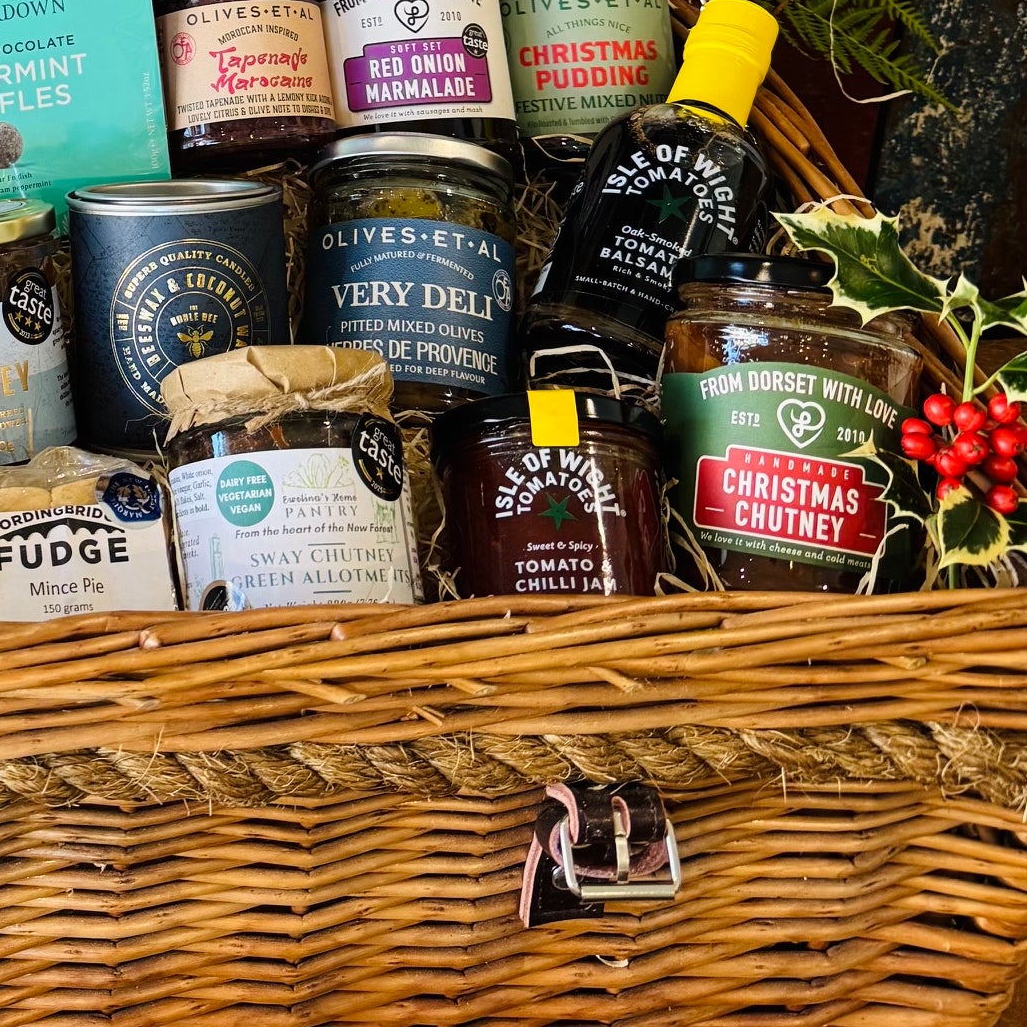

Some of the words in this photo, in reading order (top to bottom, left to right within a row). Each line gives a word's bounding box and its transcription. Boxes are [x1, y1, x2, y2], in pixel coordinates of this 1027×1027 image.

[546, 25, 564, 38] ALL
[565, 18, 605, 30] THINGS
[608, 20, 631, 33] NICE
[390, 43, 416, 54] SOFT
[423, 42, 441, 51] SET
[519, 40, 657, 67] CHRISTMAS
[209, 47, 308, 73] Tapenade
[369, 59, 404, 79] RED
[411, 54, 466, 74] ONION
[211, 73, 313, 94] Marocaine
[536, 66, 649, 91] PUDDING
[366, 77, 475, 103] MARMALADE
[602, 152, 649, 194] ISLE
[655, 144, 689, 162] OF
[693, 154, 735, 241] WIGHT
[626, 167, 714, 224] TOMATOES
[9, 286, 52, 324] taste
[331, 281, 414, 309] VERY
[422, 283, 493, 321] DELI
[341, 320, 383, 333] PITTED
[387, 320, 435, 334] MIXED
[439, 324, 484, 343] OLIVES
[220, 477, 244, 488] DAIRY
[246, 475, 267, 484] FREE
[723, 468, 859, 515] CHRISTMAS
[219, 488, 272, 501] VEGETARIAN
[230, 503, 261, 514] VEGAN
[285, 506, 358, 518] PANTRY
[735, 501, 844, 543] CHUTNEY
[251, 550, 303, 567] SWAY
[311, 548, 394, 564] CHUTNEY
[515, 559, 594, 574] TOMATO
[30, 580, 78, 596] Mince
[83, 578, 104, 593] Pie
[516, 577, 576, 592] CHILLI
[583, 577, 617, 592] JAM
[43, 605, 61, 613] 150
[64, 603, 93, 614] grams
